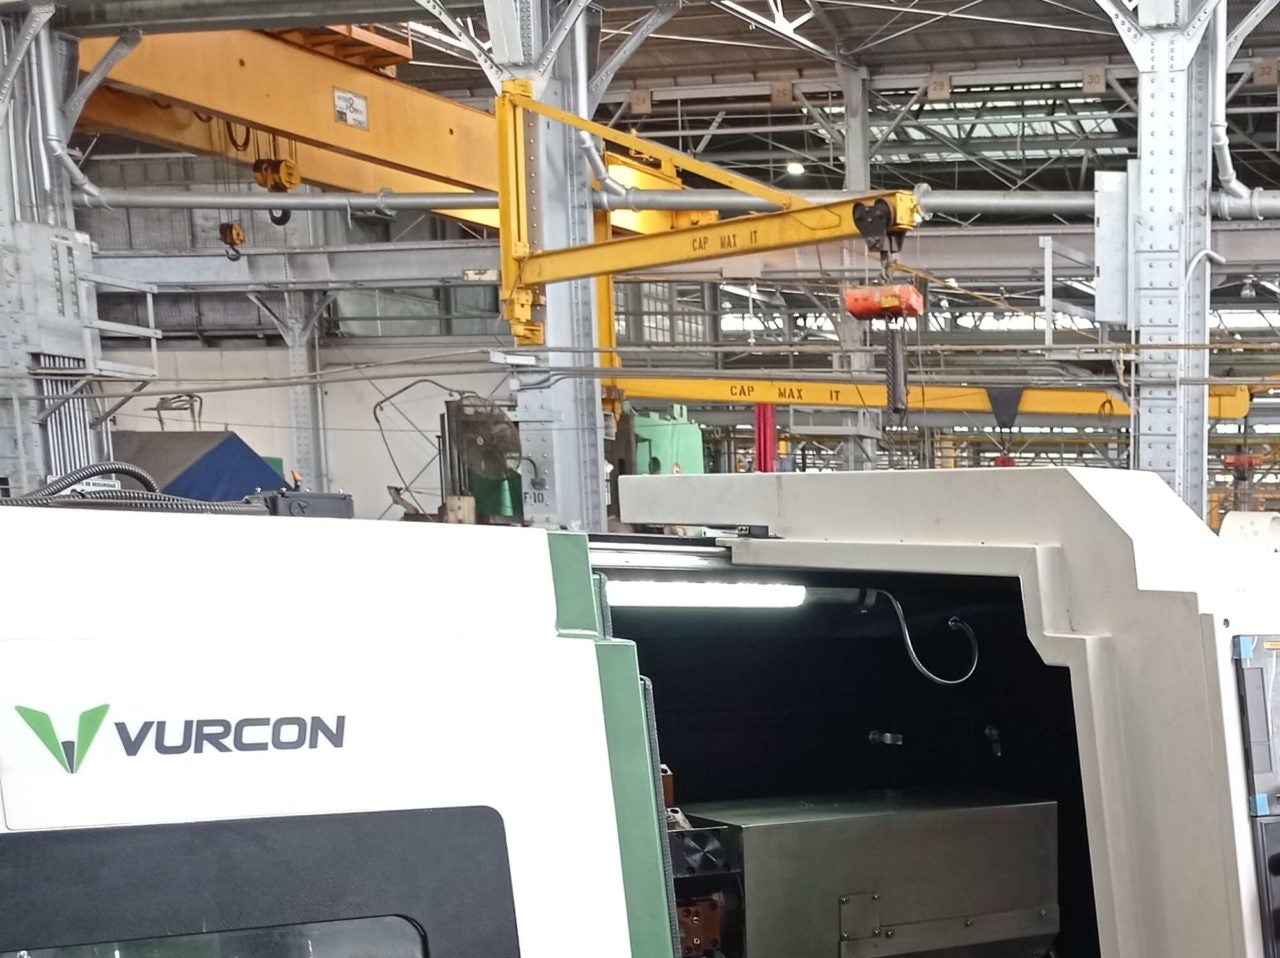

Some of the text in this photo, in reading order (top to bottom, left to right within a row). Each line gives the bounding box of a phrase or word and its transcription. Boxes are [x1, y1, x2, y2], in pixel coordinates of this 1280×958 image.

[1258, 65, 1273, 77] 32
[1087, 74, 1100, 85] 30
[692, 236, 708, 251] CAP
[720, 234, 737, 249] MAX
[730, 385, 755, 397] CAP
[778, 387, 803, 400] MAX
[524, 492, 544, 504] F-10
[114, 715, 346, 757] VURCON
